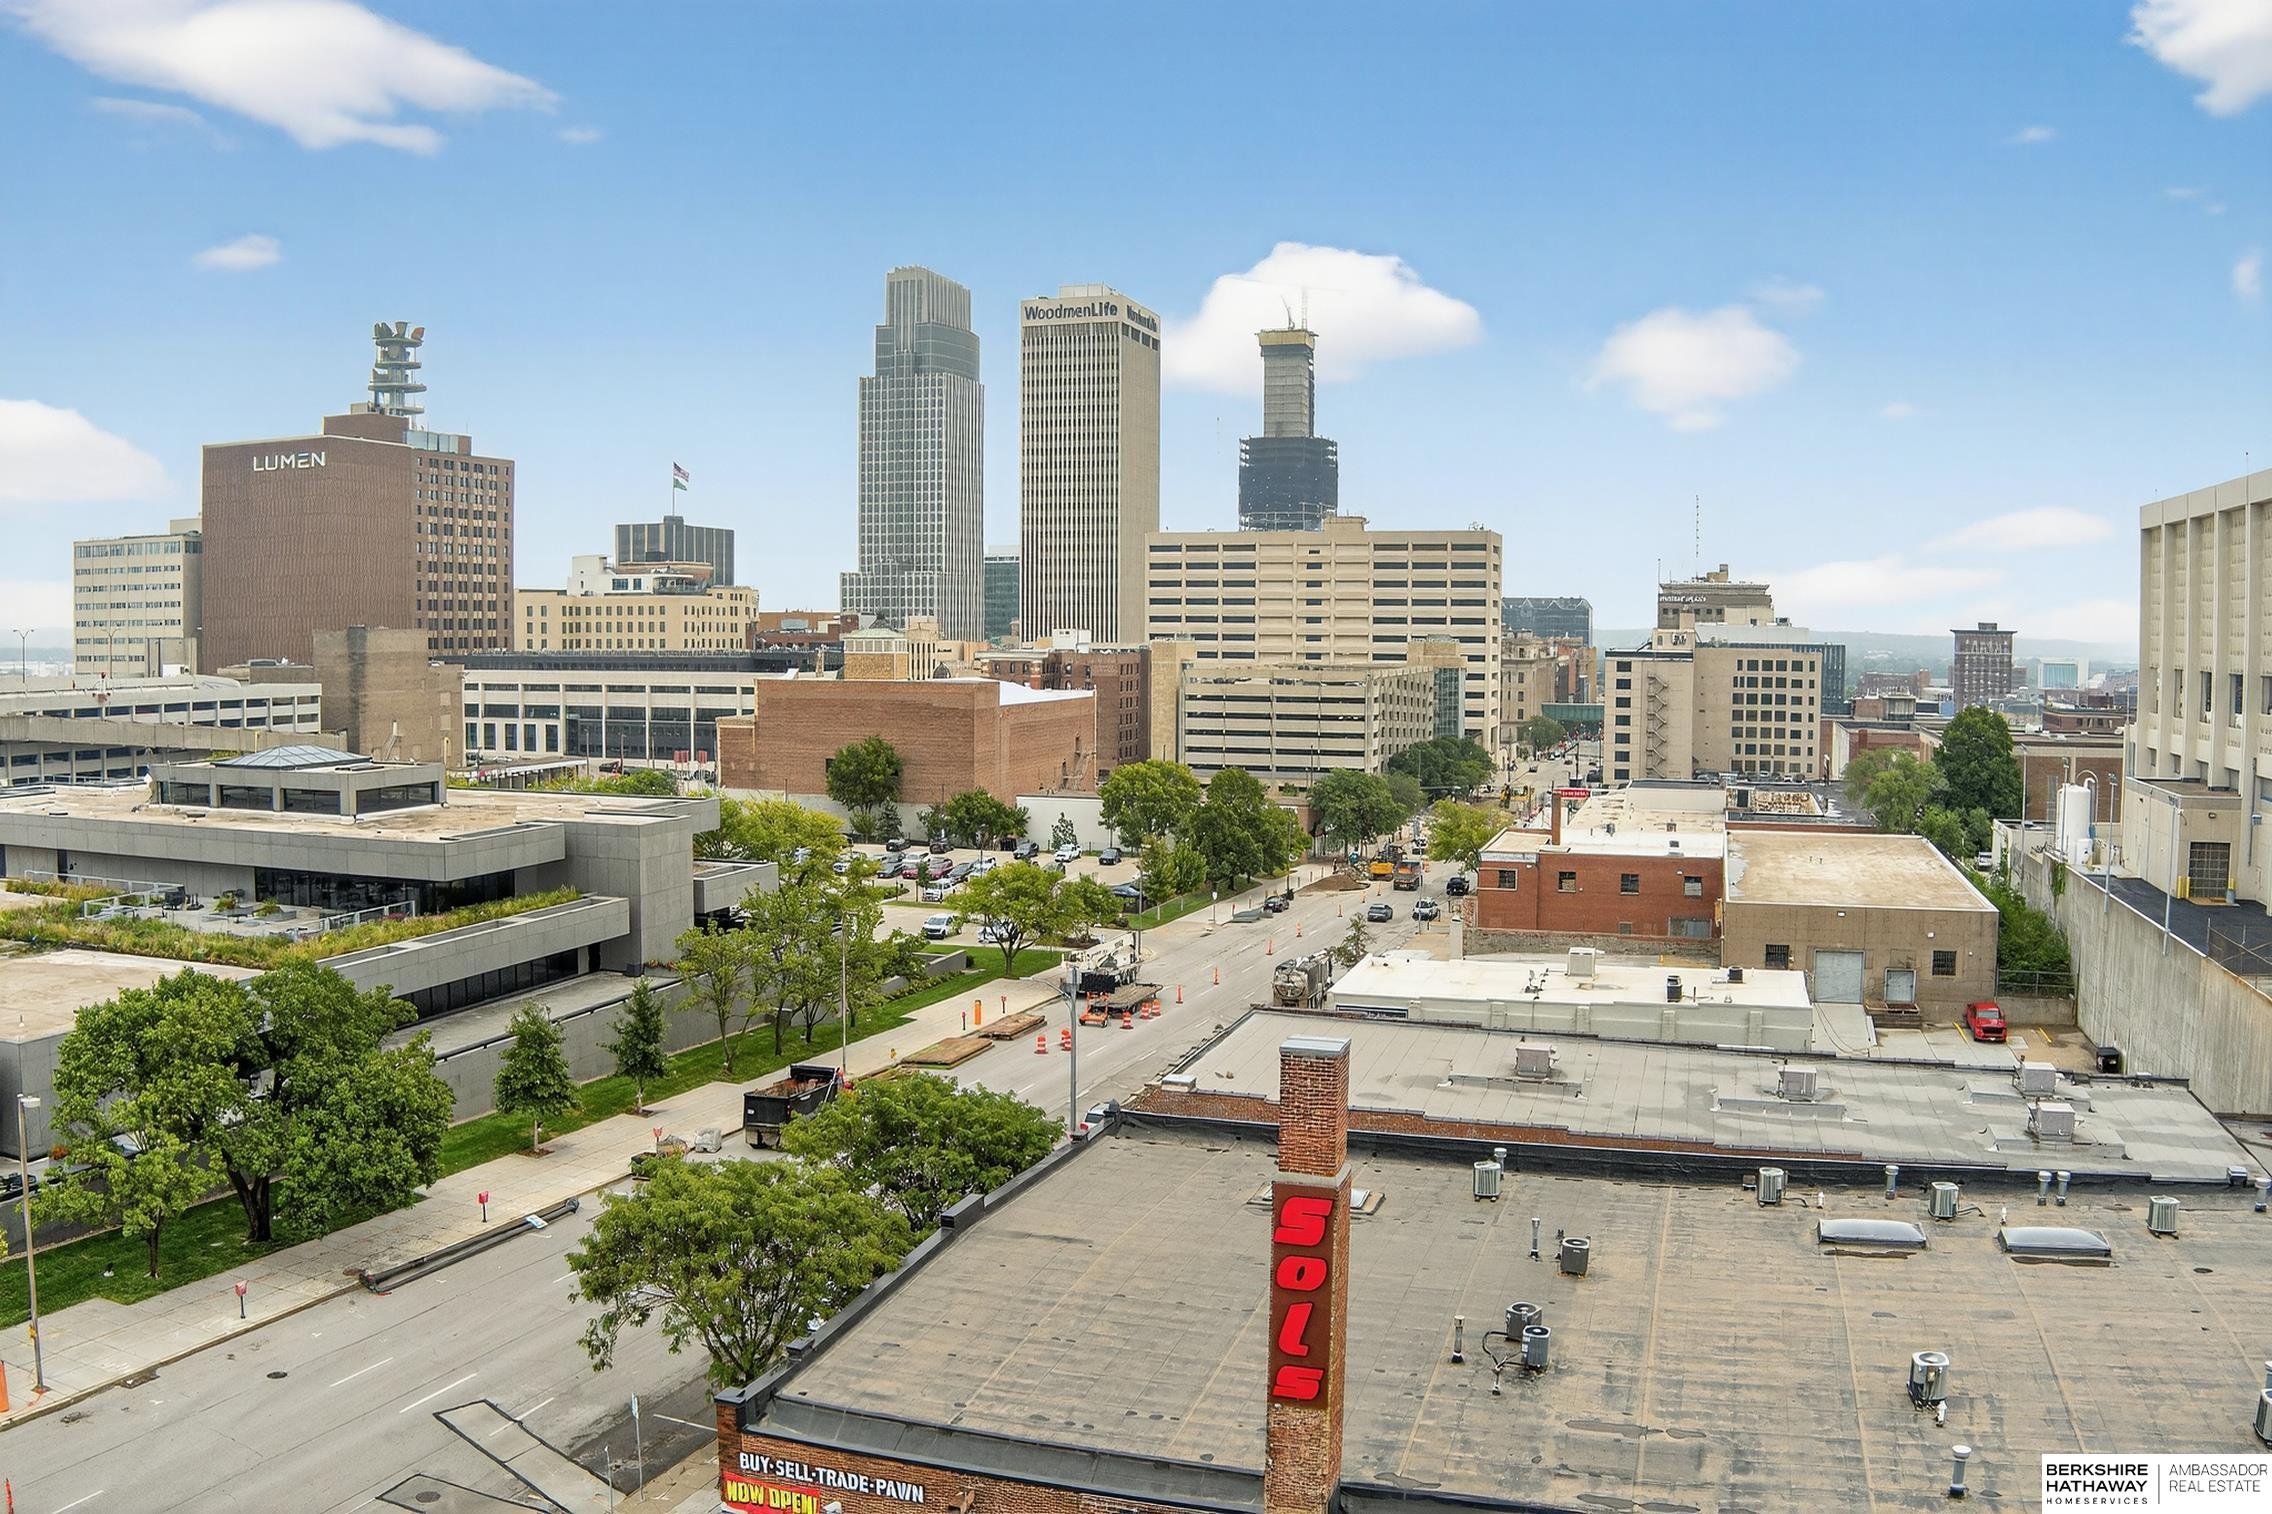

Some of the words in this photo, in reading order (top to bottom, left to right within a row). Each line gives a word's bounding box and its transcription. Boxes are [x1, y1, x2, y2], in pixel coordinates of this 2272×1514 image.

[1025, 302, 1118, 320] WoodmenLife
[253, 451, 326, 472] LUMEN
[726, 1480, 764, 1506] NOW
